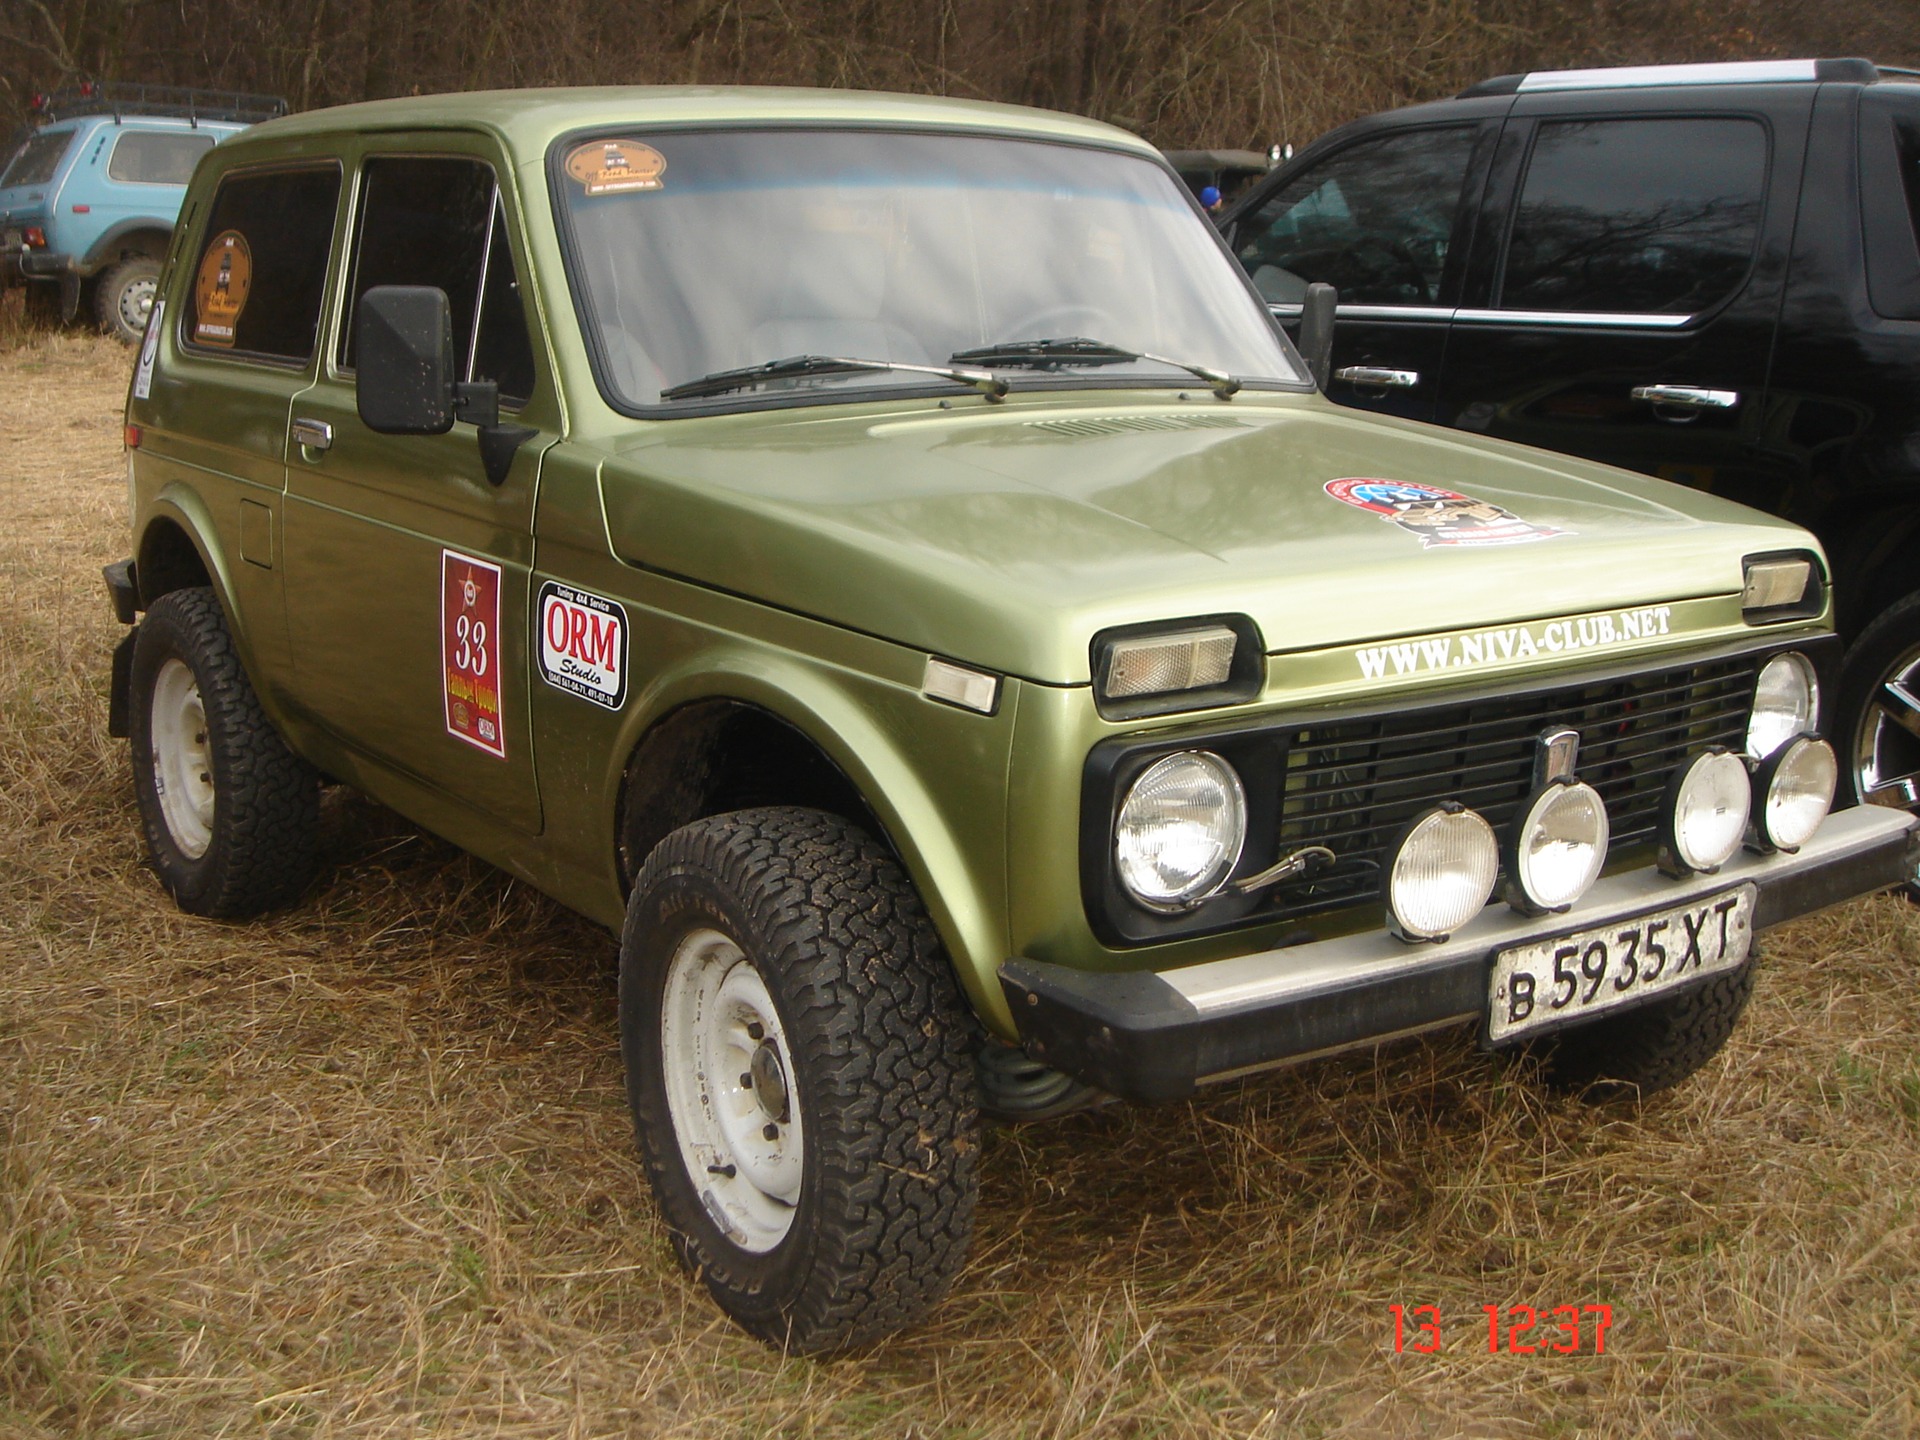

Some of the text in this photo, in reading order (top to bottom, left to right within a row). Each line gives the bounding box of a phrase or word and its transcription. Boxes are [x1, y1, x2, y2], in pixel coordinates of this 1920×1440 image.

[557, 586, 610, 612] Tuning 4x4 Service
[455, 614, 487, 676] 33
[547, 600, 617, 673] ORM
[1354, 606, 1671, 681] WWW.NIVA-CLUB.NET
[559, 658, 602, 685] Studio
[1551, 919, 1669, 1010] 5935
